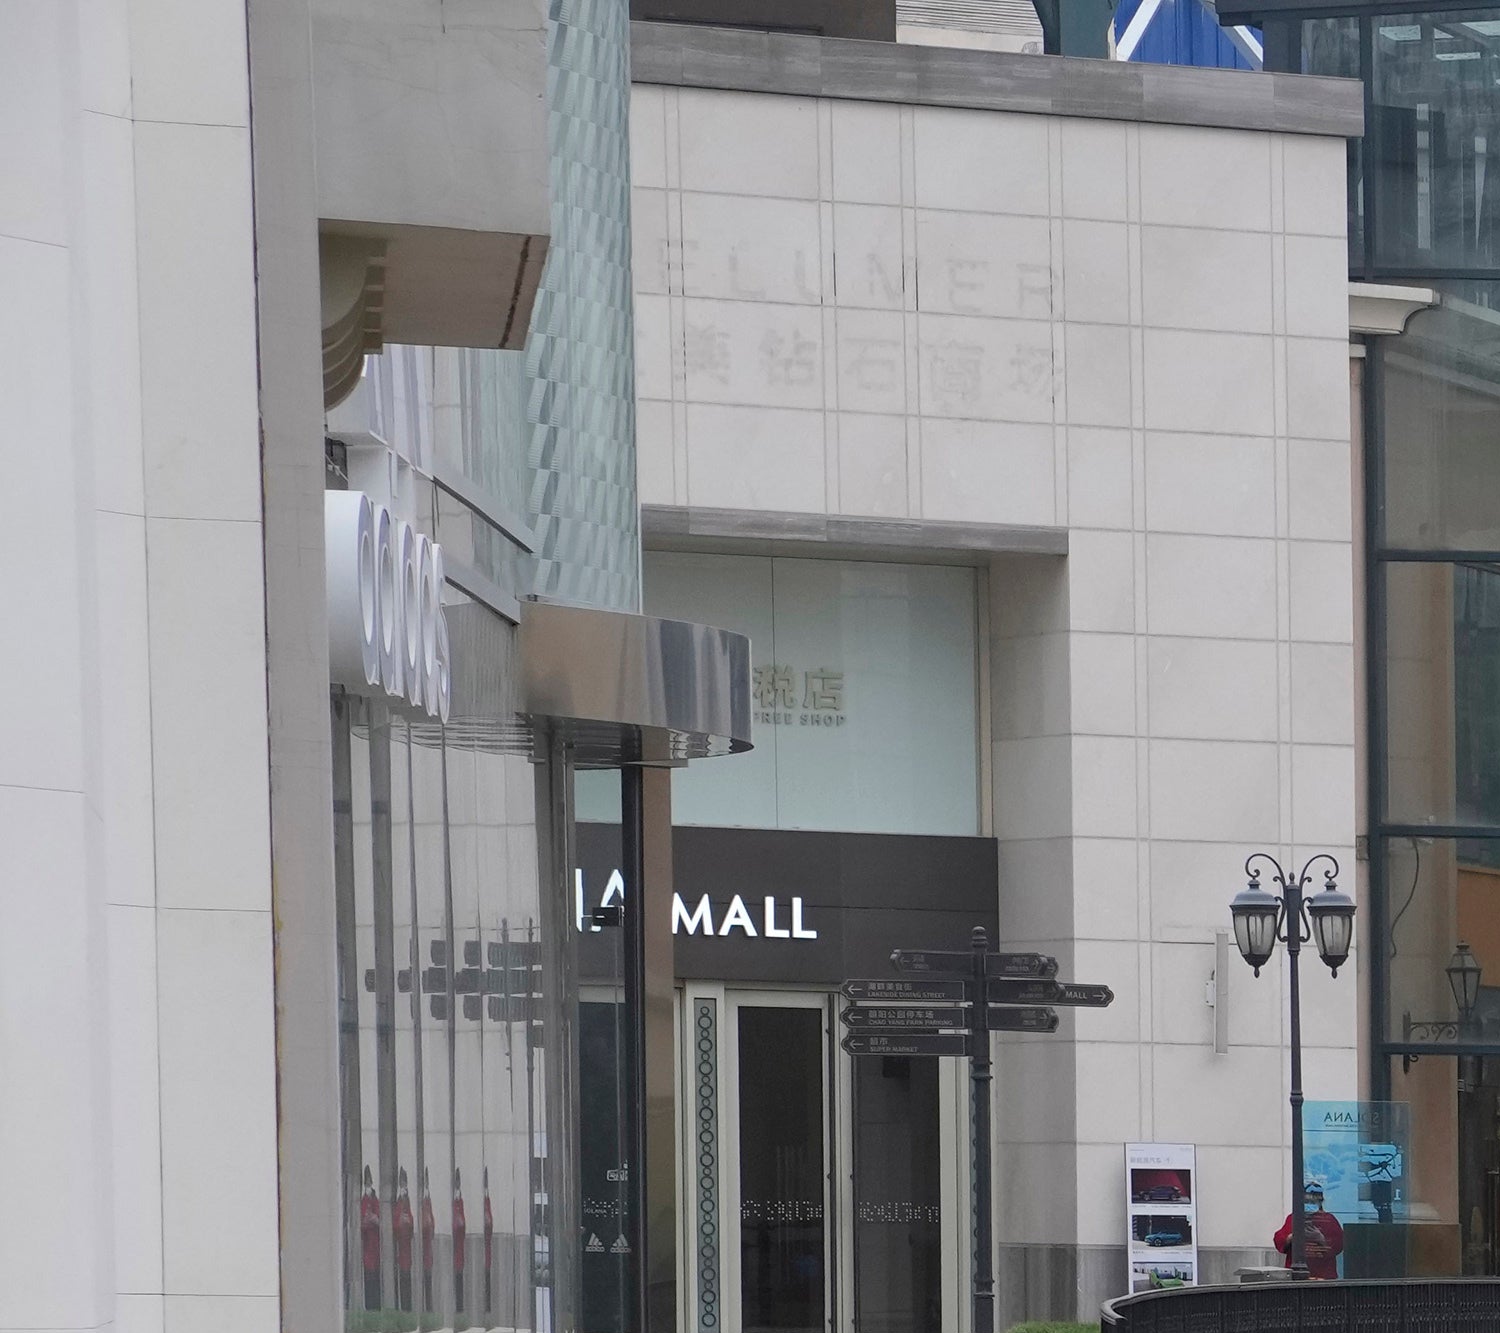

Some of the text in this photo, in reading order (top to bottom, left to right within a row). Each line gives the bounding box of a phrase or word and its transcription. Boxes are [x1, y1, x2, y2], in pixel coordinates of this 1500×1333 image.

[799, 713, 847, 727] SHOP
[672, 891, 818, 940] MALL
[1065, 991, 1088, 1000] MALL
